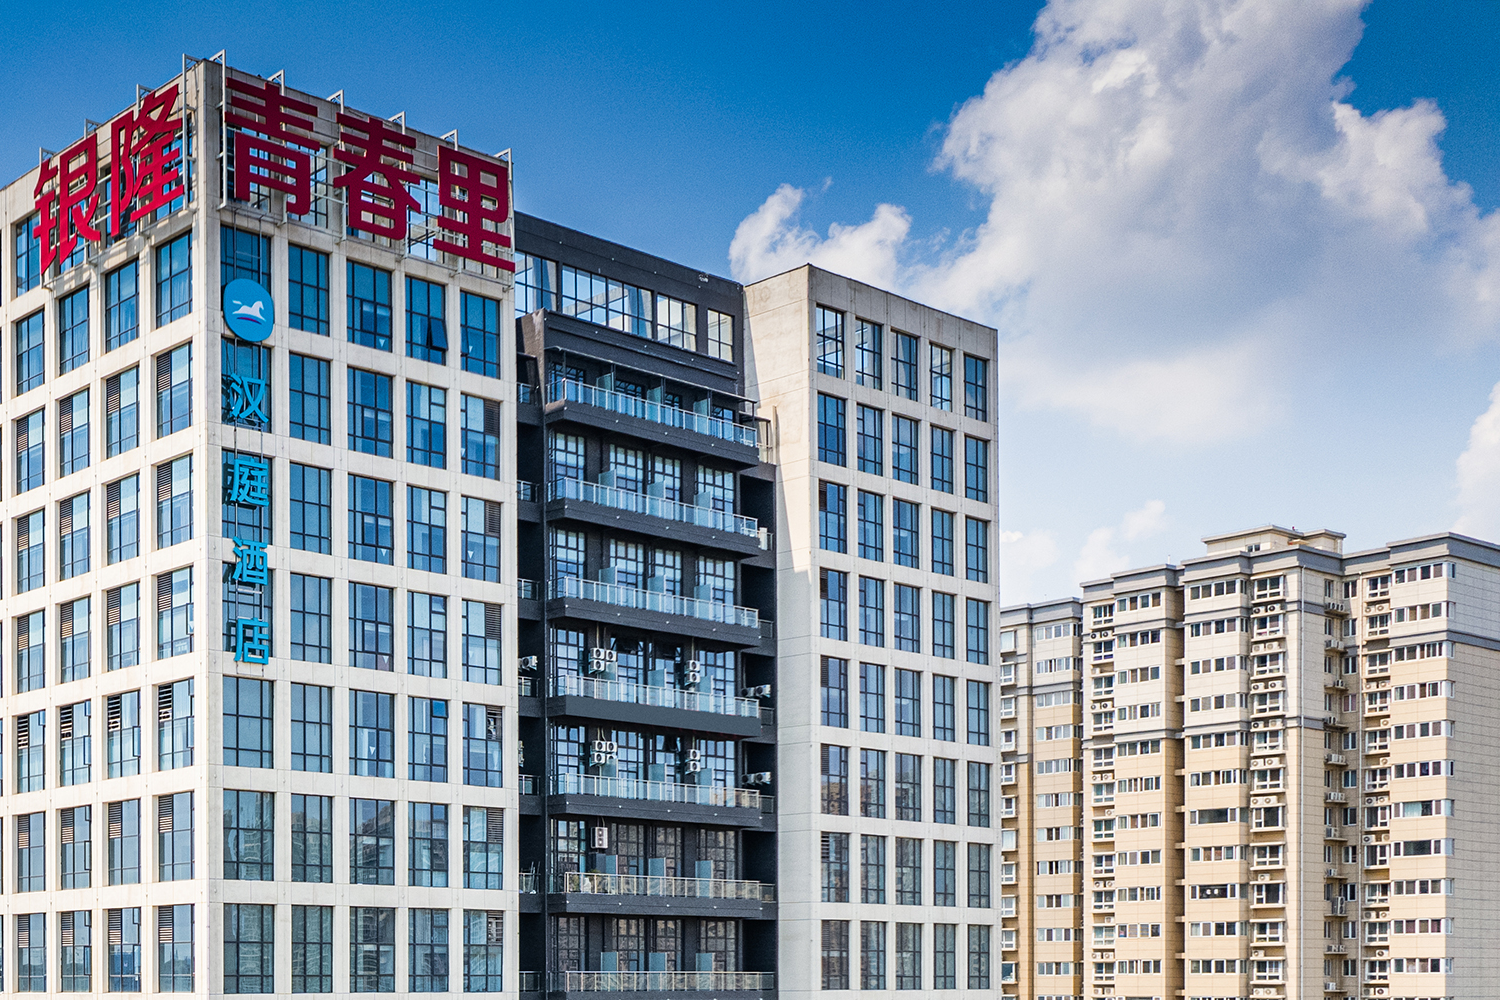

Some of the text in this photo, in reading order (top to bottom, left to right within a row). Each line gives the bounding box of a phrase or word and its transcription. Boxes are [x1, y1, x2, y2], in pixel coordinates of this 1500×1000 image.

[33, 83, 185, 275] 银隆
[224, 77, 515, 272] 青春里
[229, 372, 269, 666] 汉庭酒店
